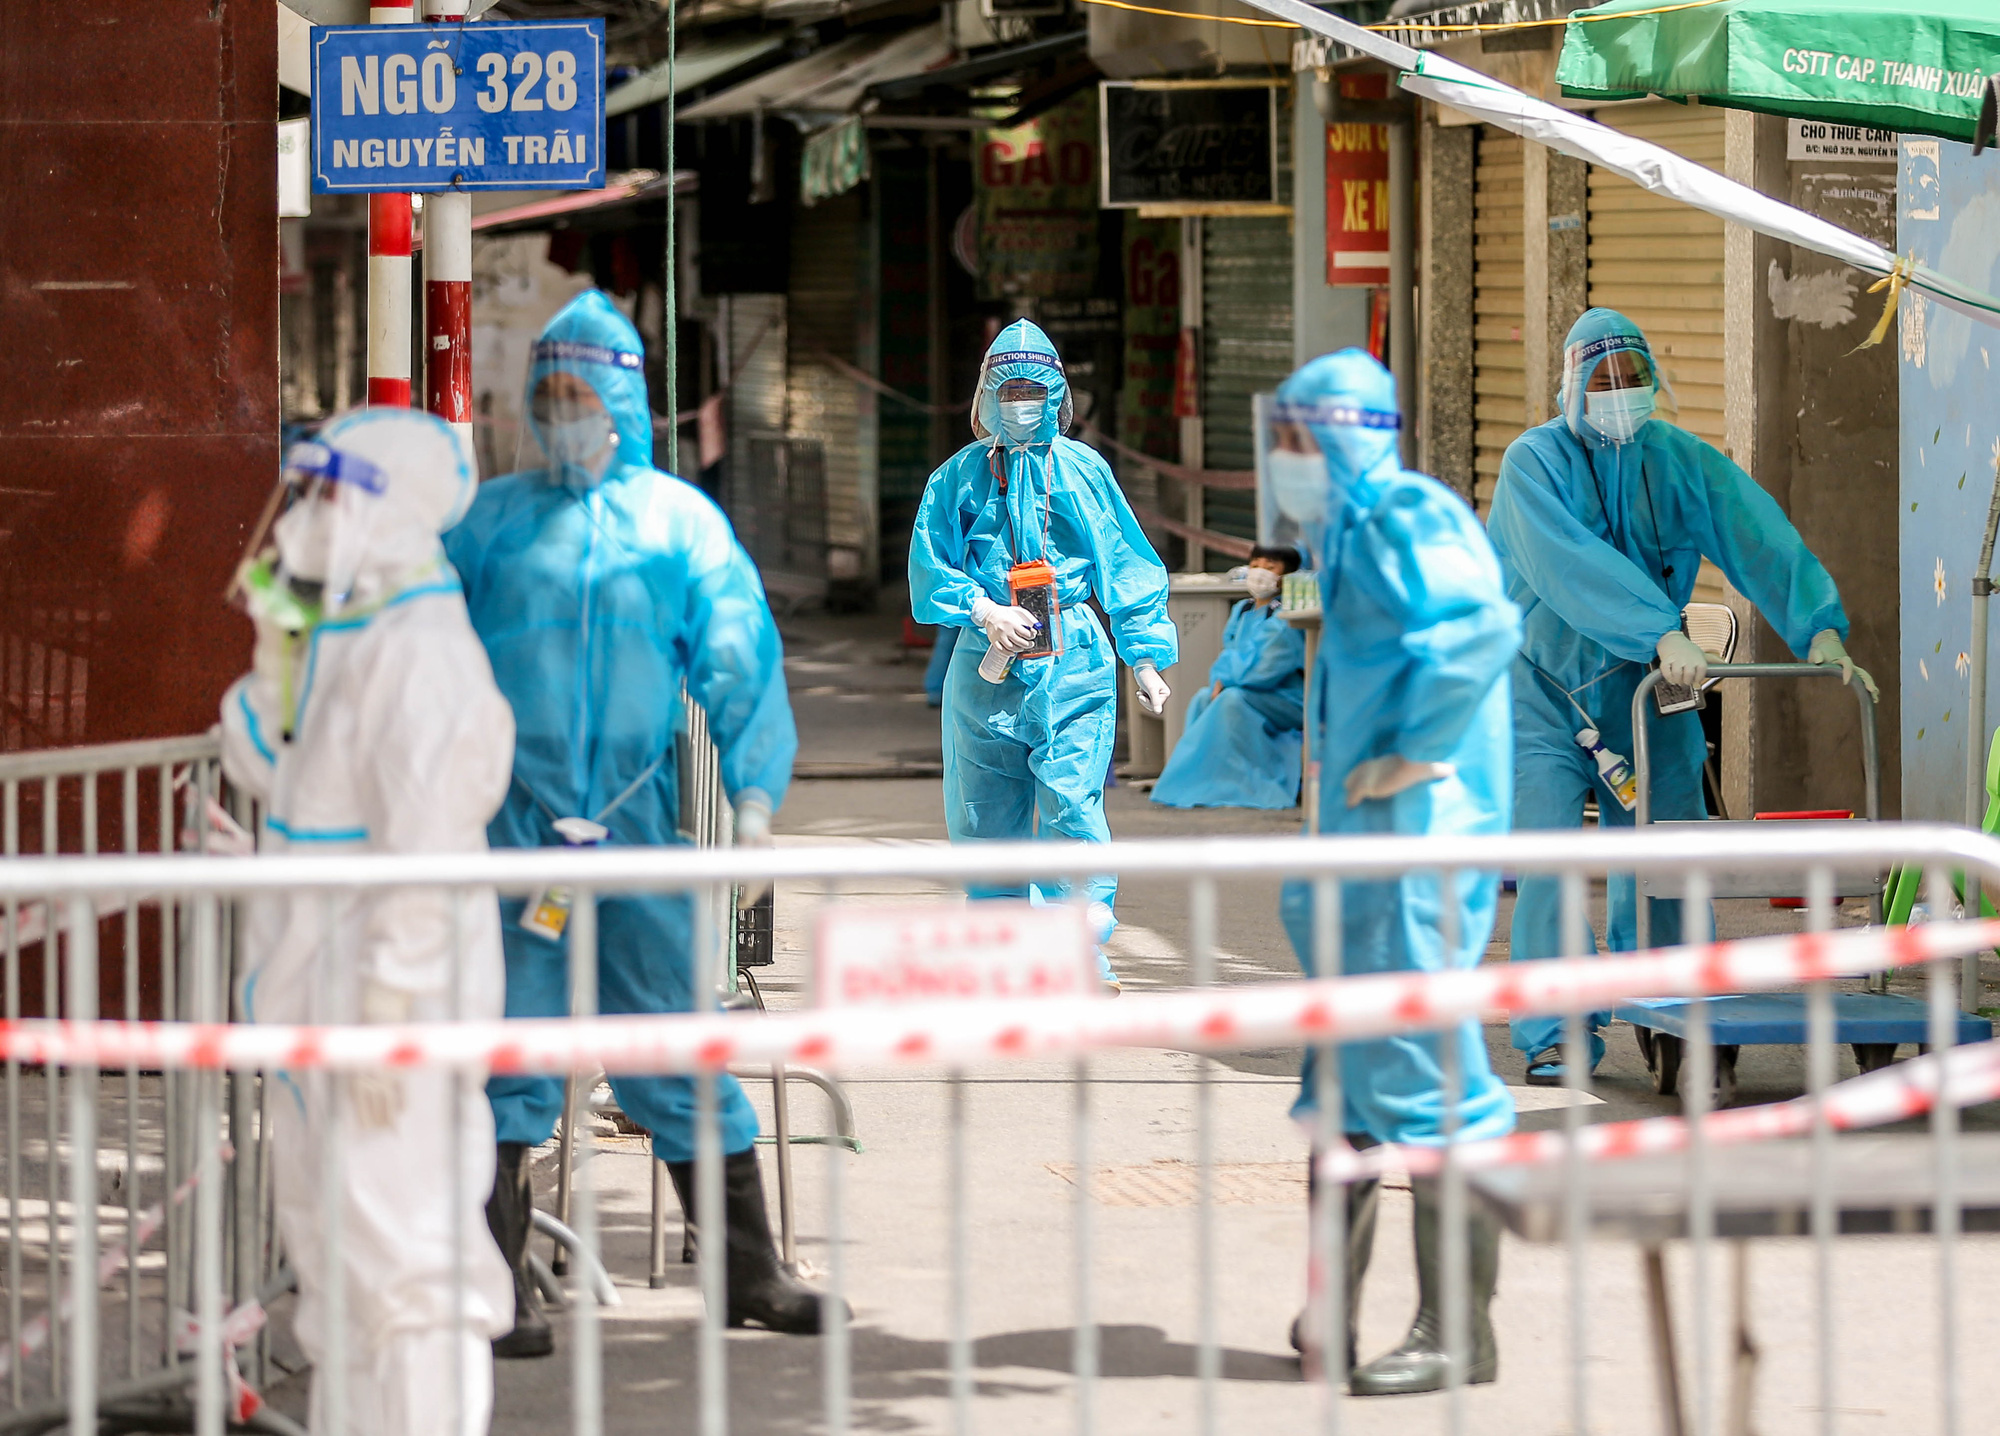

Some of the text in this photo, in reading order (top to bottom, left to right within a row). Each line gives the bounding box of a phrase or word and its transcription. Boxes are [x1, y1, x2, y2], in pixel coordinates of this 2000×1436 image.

[341, 40, 577, 116] NGÕ 328
[1783, 48, 1834, 76] CSTT
[1835, 55, 1876, 84] CAP.
[1882, 60, 1943, 93] THANH
[333, 126, 586, 168] NGUYỄN TRÃI
[1801, 124, 1826, 139] CHO
[1342, 180, 1369, 231] XE
[1028, 352, 1052, 363] SHIELD
